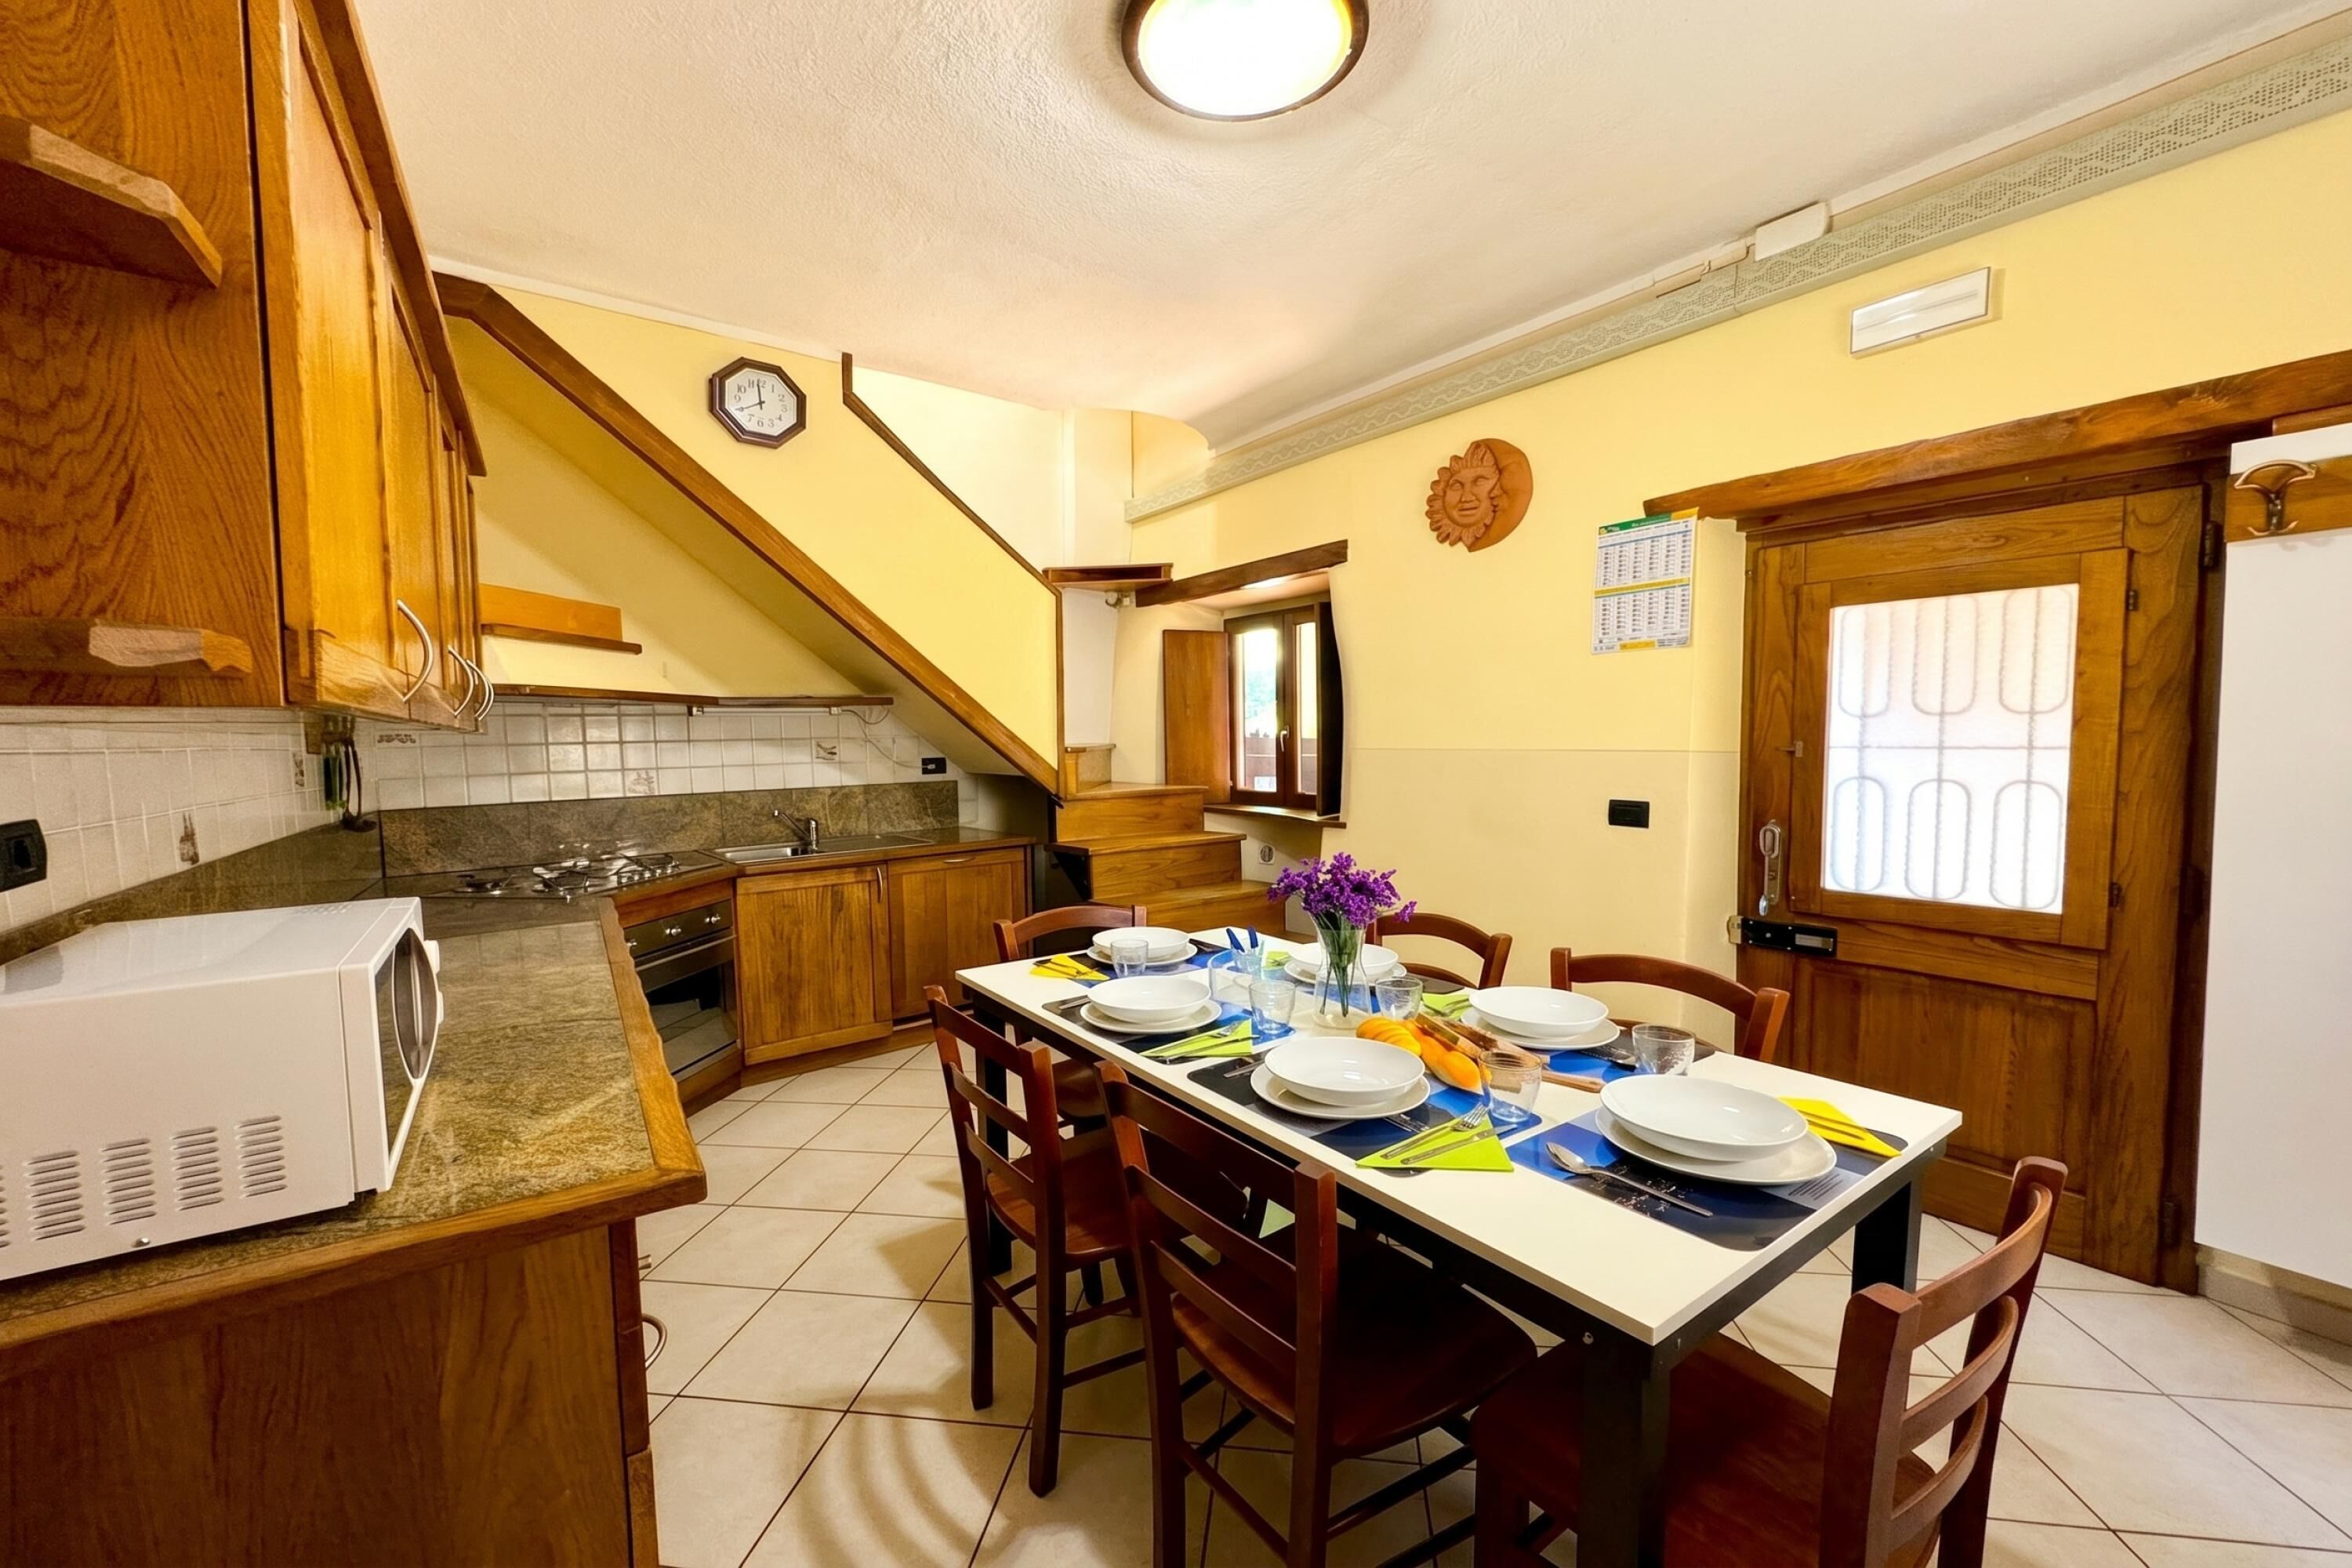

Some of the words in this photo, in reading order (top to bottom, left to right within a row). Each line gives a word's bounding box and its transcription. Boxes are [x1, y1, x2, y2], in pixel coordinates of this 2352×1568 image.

[737, 383, 746, 394] 10
[771, 384, 775, 393] 1
[734, 394, 741, 403] 9
[778, 394, 785, 402] 2
